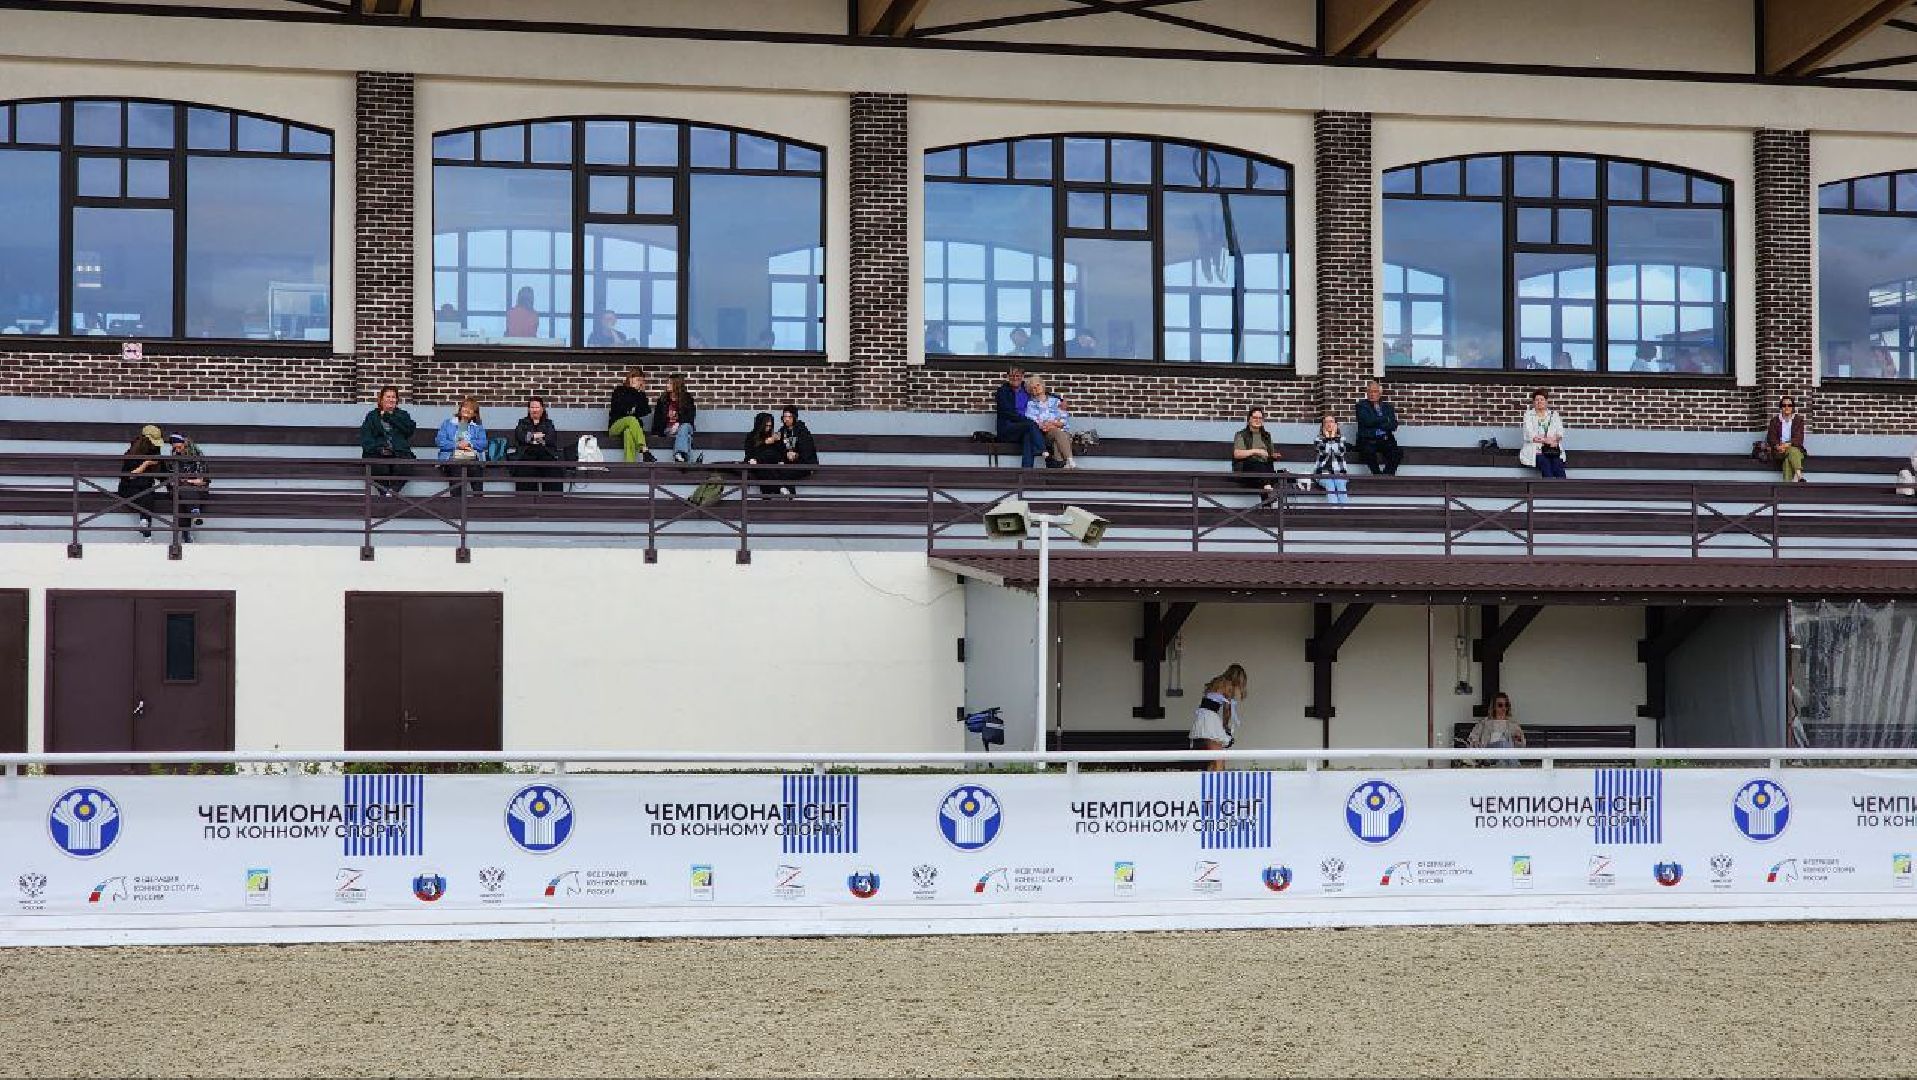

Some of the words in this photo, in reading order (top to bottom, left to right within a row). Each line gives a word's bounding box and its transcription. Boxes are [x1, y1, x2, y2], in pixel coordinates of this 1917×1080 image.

[645, 803, 796, 821] ЧЕМПИОНАТ
[803, 803, 850, 821] СНГ
[1071, 800, 1213, 819] ЧЕМПИОНАТ
[1221, 799, 1264, 817] СНГ
[1470, 796, 1606, 814] ЧЕМПИОНАТ
[1612, 796, 1654, 813] СНГ
[199, 804, 357, 823] ЧЕМПИОНАТ
[365, 804, 414, 823] СНГ
[1857, 815, 1879, 827] ПО
[1883, 815, 1917, 827] КОН
[650, 823, 676, 836] ПО
[681, 823, 769, 836] КОННОМУ
[774, 822, 843, 836] СПОРТУ
[1075, 820, 1100, 834] ПО
[1105, 820, 1188, 833] КОННОМУ
[1192, 819, 1258, 832] СПОРТУ
[1475, 815, 1498, 828] ПО
[1502, 815, 1581, 828] КОННОМУ
[1586, 815, 1649, 828] СПОРТУ
[204, 825, 231, 839] ПО
[236, 825, 329, 839] КОННОМУ
[335, 825, 408, 838] СПОРТУ
